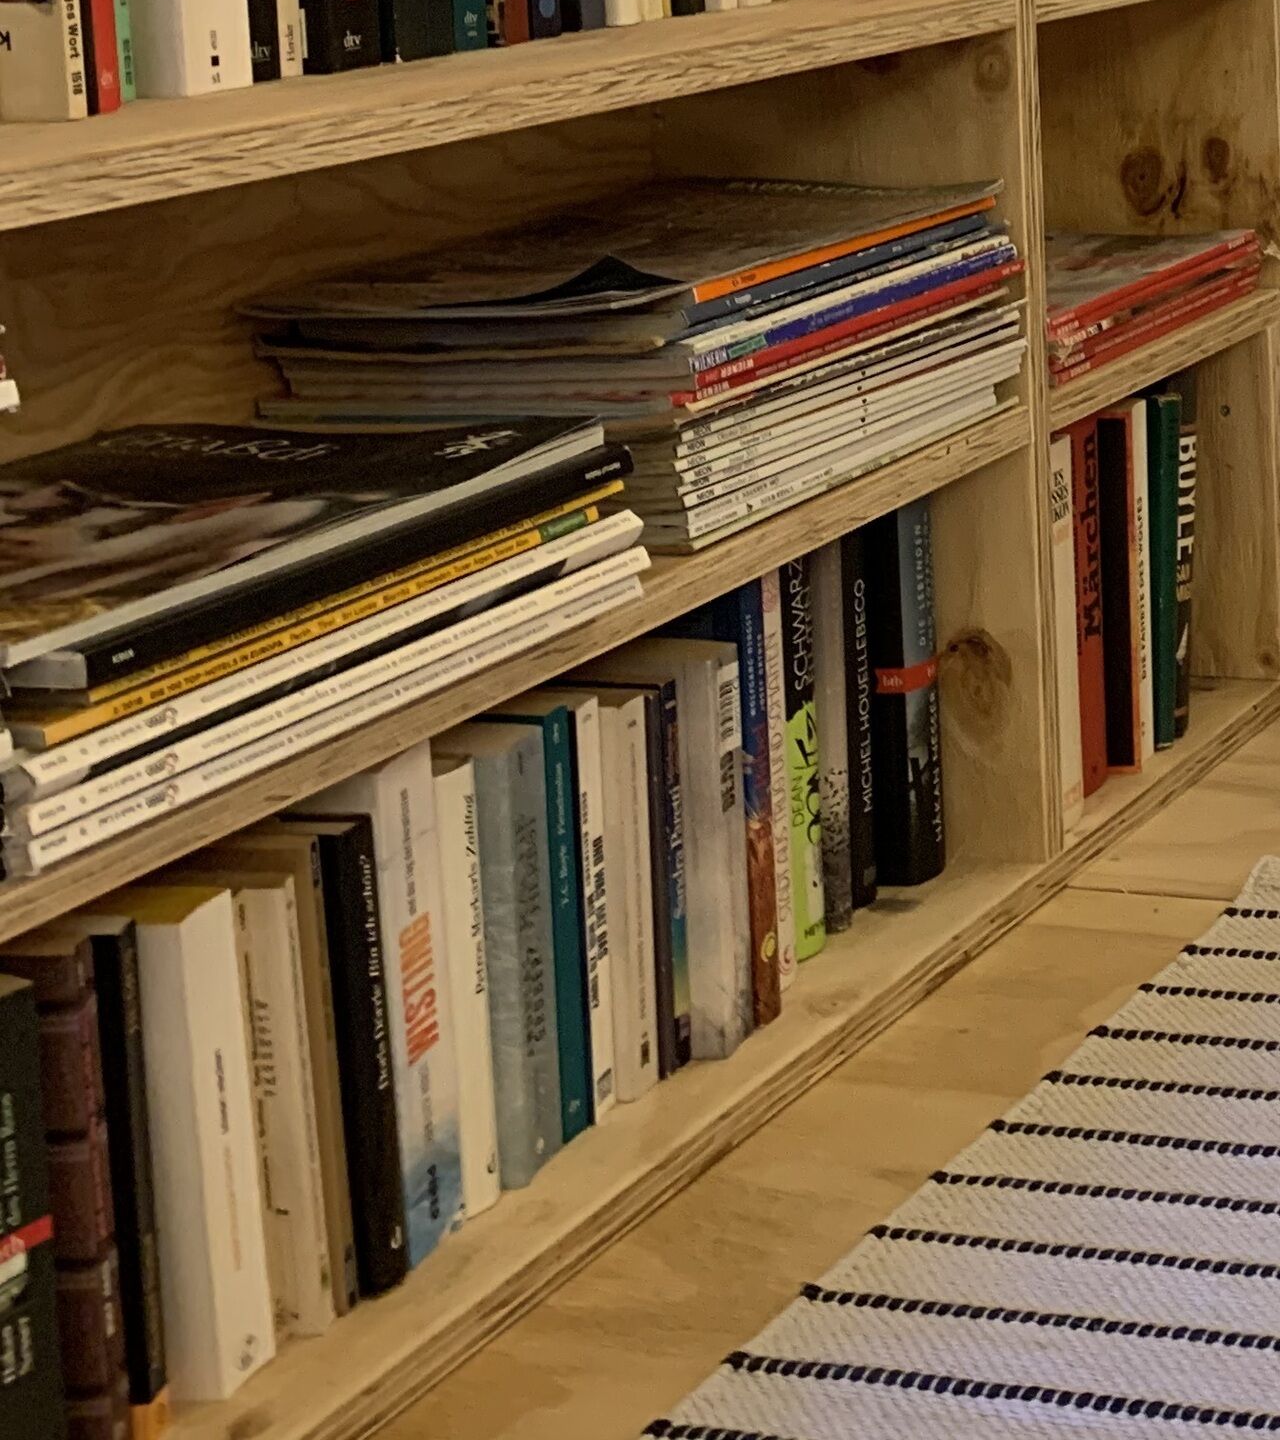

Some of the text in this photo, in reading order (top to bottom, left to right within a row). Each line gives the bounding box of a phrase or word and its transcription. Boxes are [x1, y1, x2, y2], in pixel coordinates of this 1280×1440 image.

[67, 23, 80, 59] Wort
[1177, 435, 1197, 561] BOYLE
[1080, 432, 1101, 641] Märchen
[917, 619, 927, 646] DIE
[853, 579, 873, 813] MICHEL HOUELLEBECQ
[928, 691, 938, 762] NESSER
[791, 775, 805, 828] DEAN
[593, 836, 604, 867] UND
[365, 916, 377, 942] ich
[462, 793, 486, 995] Petros Markaris Zahltag
[399, 911, 441, 1067] WISTING
